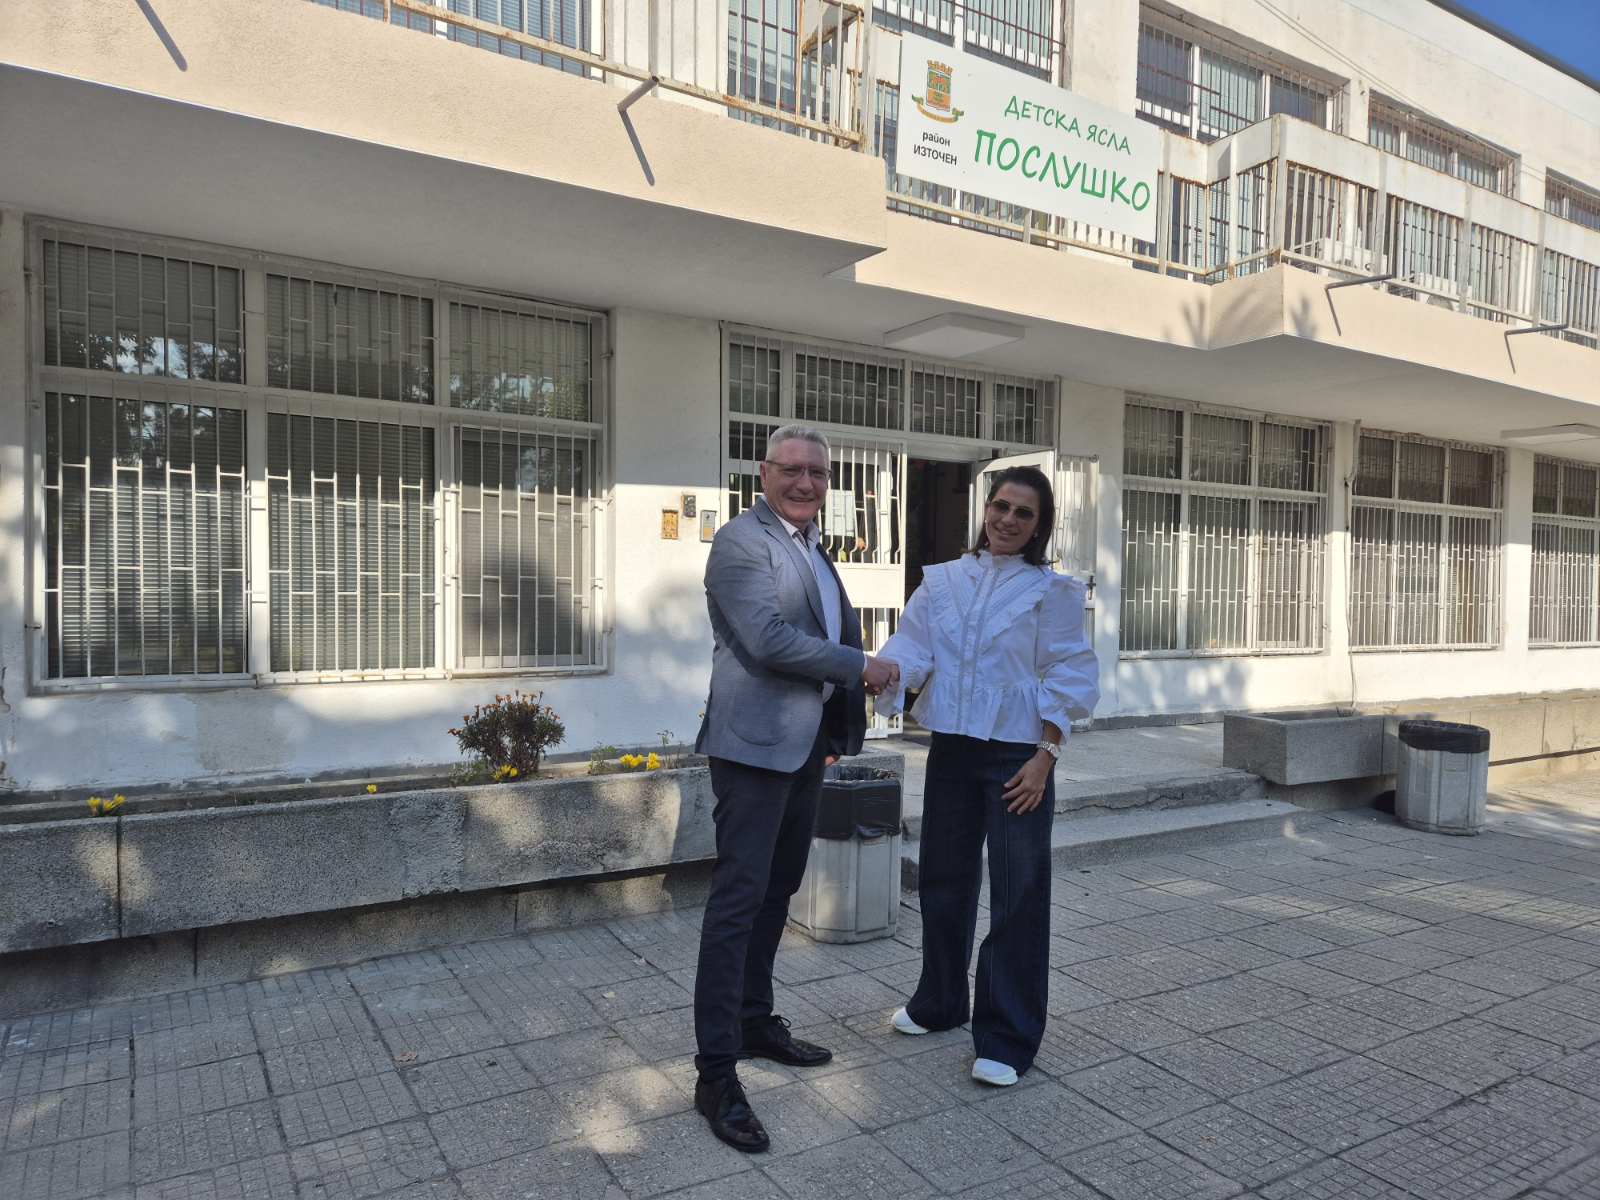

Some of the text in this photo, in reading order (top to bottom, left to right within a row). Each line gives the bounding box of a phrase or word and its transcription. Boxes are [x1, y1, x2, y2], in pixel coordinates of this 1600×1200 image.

[922, 131, 951, 147] район
[1004, 95, 1131, 155] ДЕТСКА ЯСЛА
[913, 144, 958, 166] ИЗТОЧЕН
[974, 129, 1150, 211] ПОСЛУШКО
